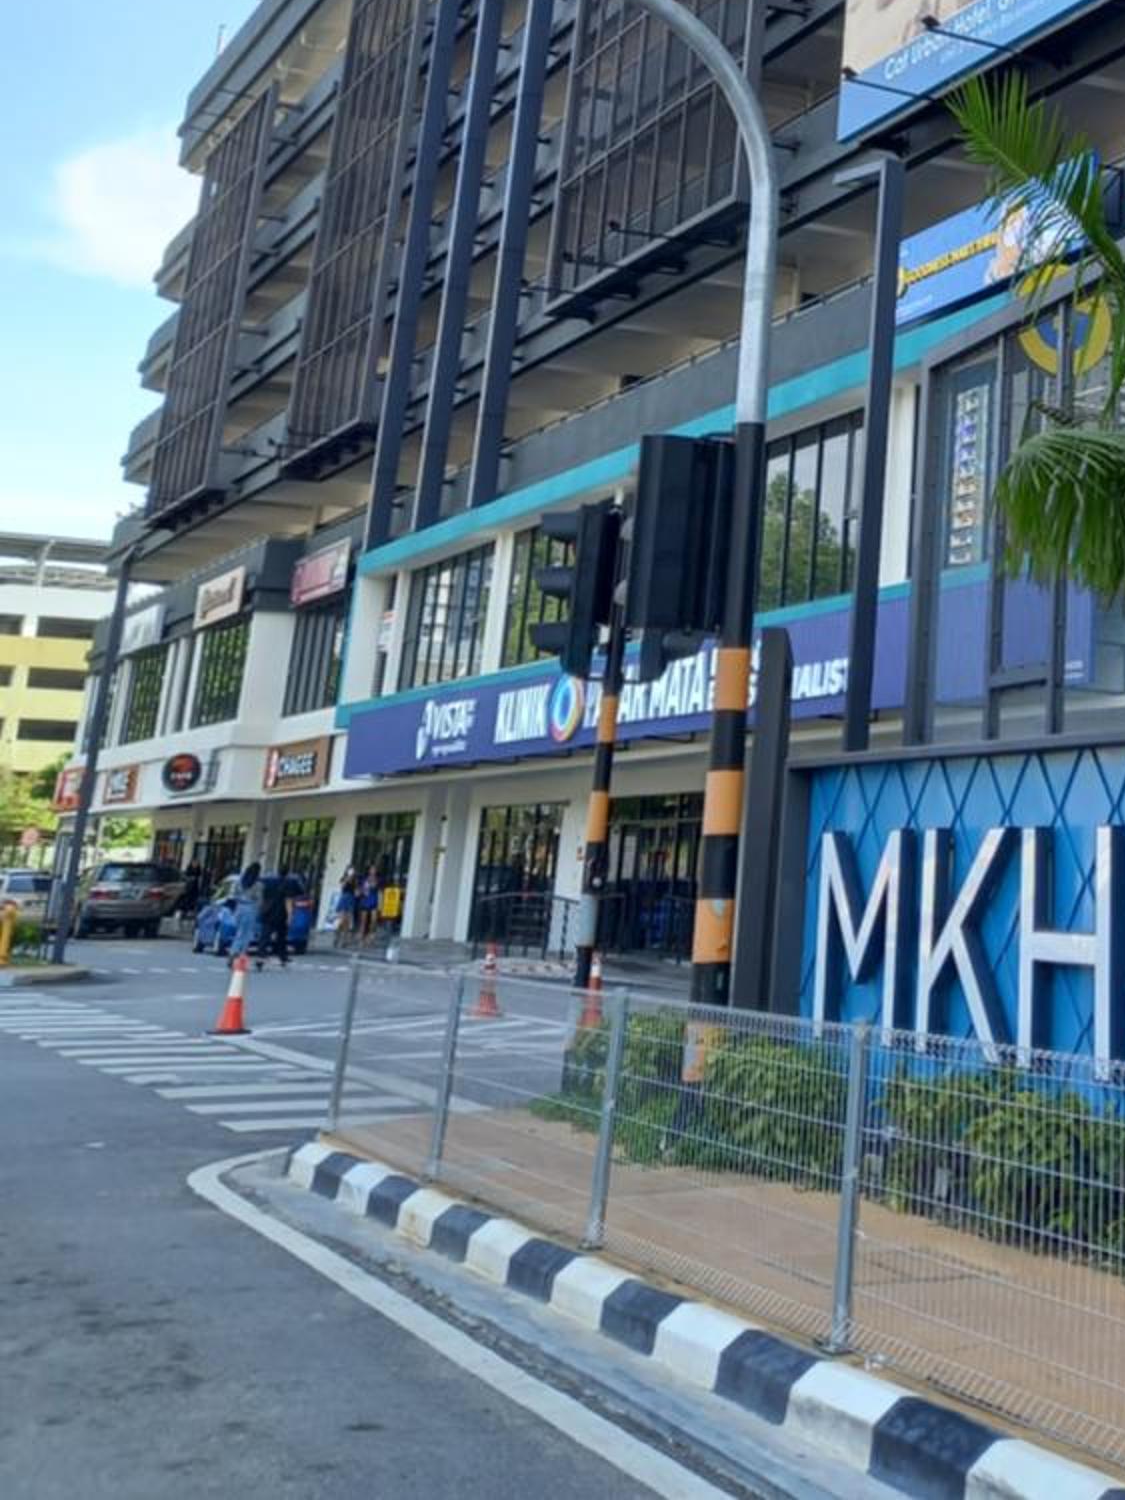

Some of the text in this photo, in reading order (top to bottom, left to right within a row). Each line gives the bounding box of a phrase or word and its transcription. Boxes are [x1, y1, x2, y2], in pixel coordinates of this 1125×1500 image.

[431, 699, 467, 741] VISTA
[494, 684, 550, 744] KLINIK
[812, 825, 1111, 1081] MKH
